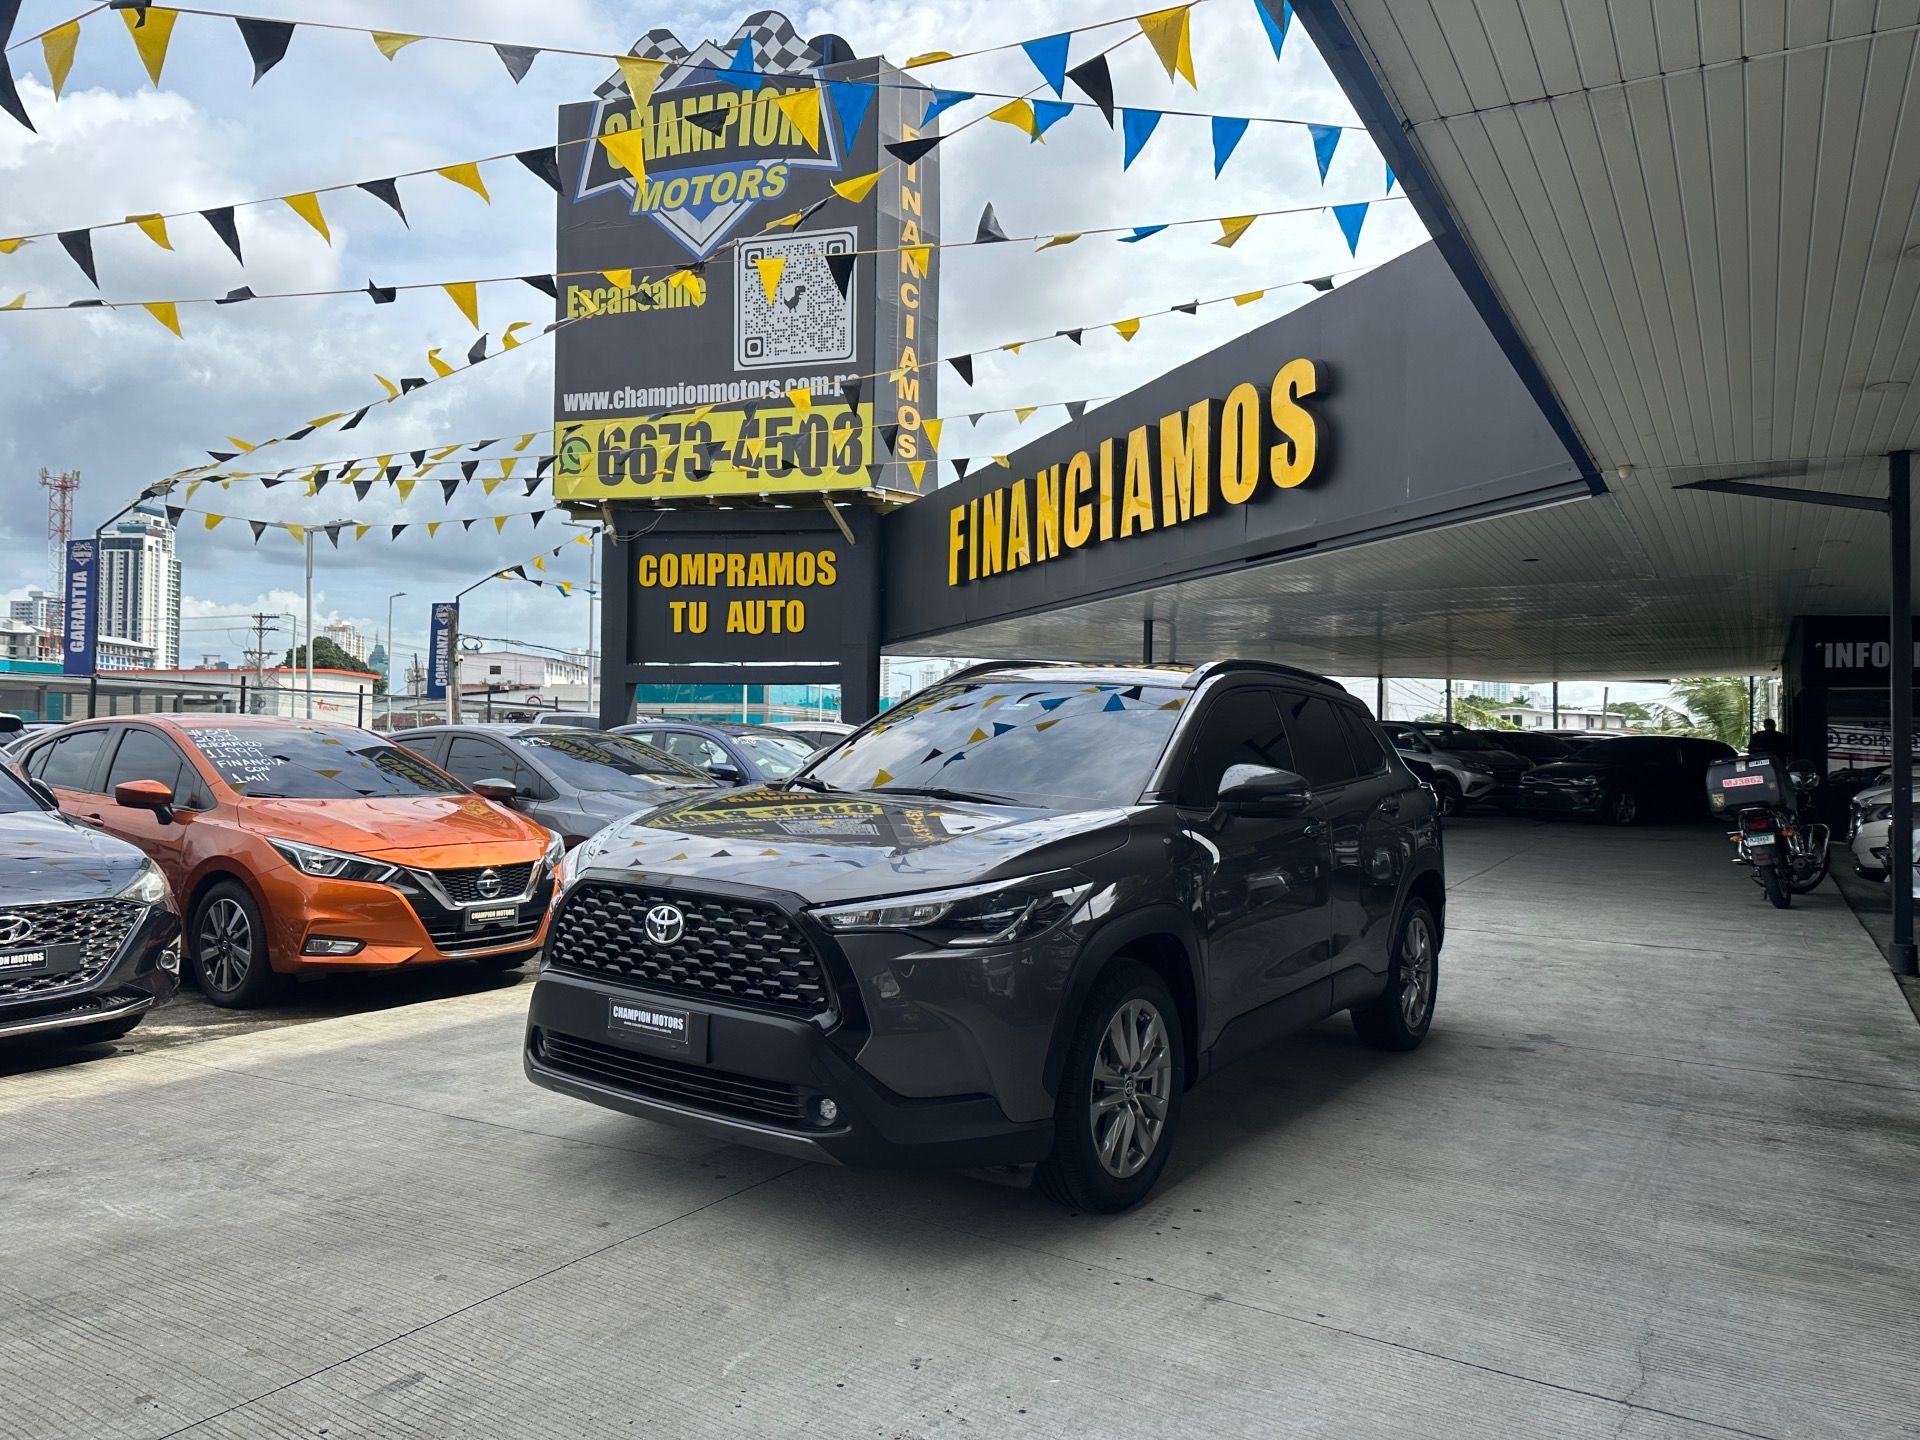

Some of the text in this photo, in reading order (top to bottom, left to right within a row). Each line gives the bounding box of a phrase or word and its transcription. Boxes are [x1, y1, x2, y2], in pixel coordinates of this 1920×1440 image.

[632, 165, 788, 213] MOTORS
[948, 357, 1318, 587] FINANCIAMOS
[638, 550, 837, 587] COMPRAMOS
[70, 570, 88, 653] GARANTIA
[669, 599, 806, 635] TU AUTO
[216, 758, 286, 769] FINANCIA
[10, 952, 45, 964] MOTORS
[612, 1005, 652, 1024] CHAMPION
[651, 1013, 684, 1031] MOTORS
